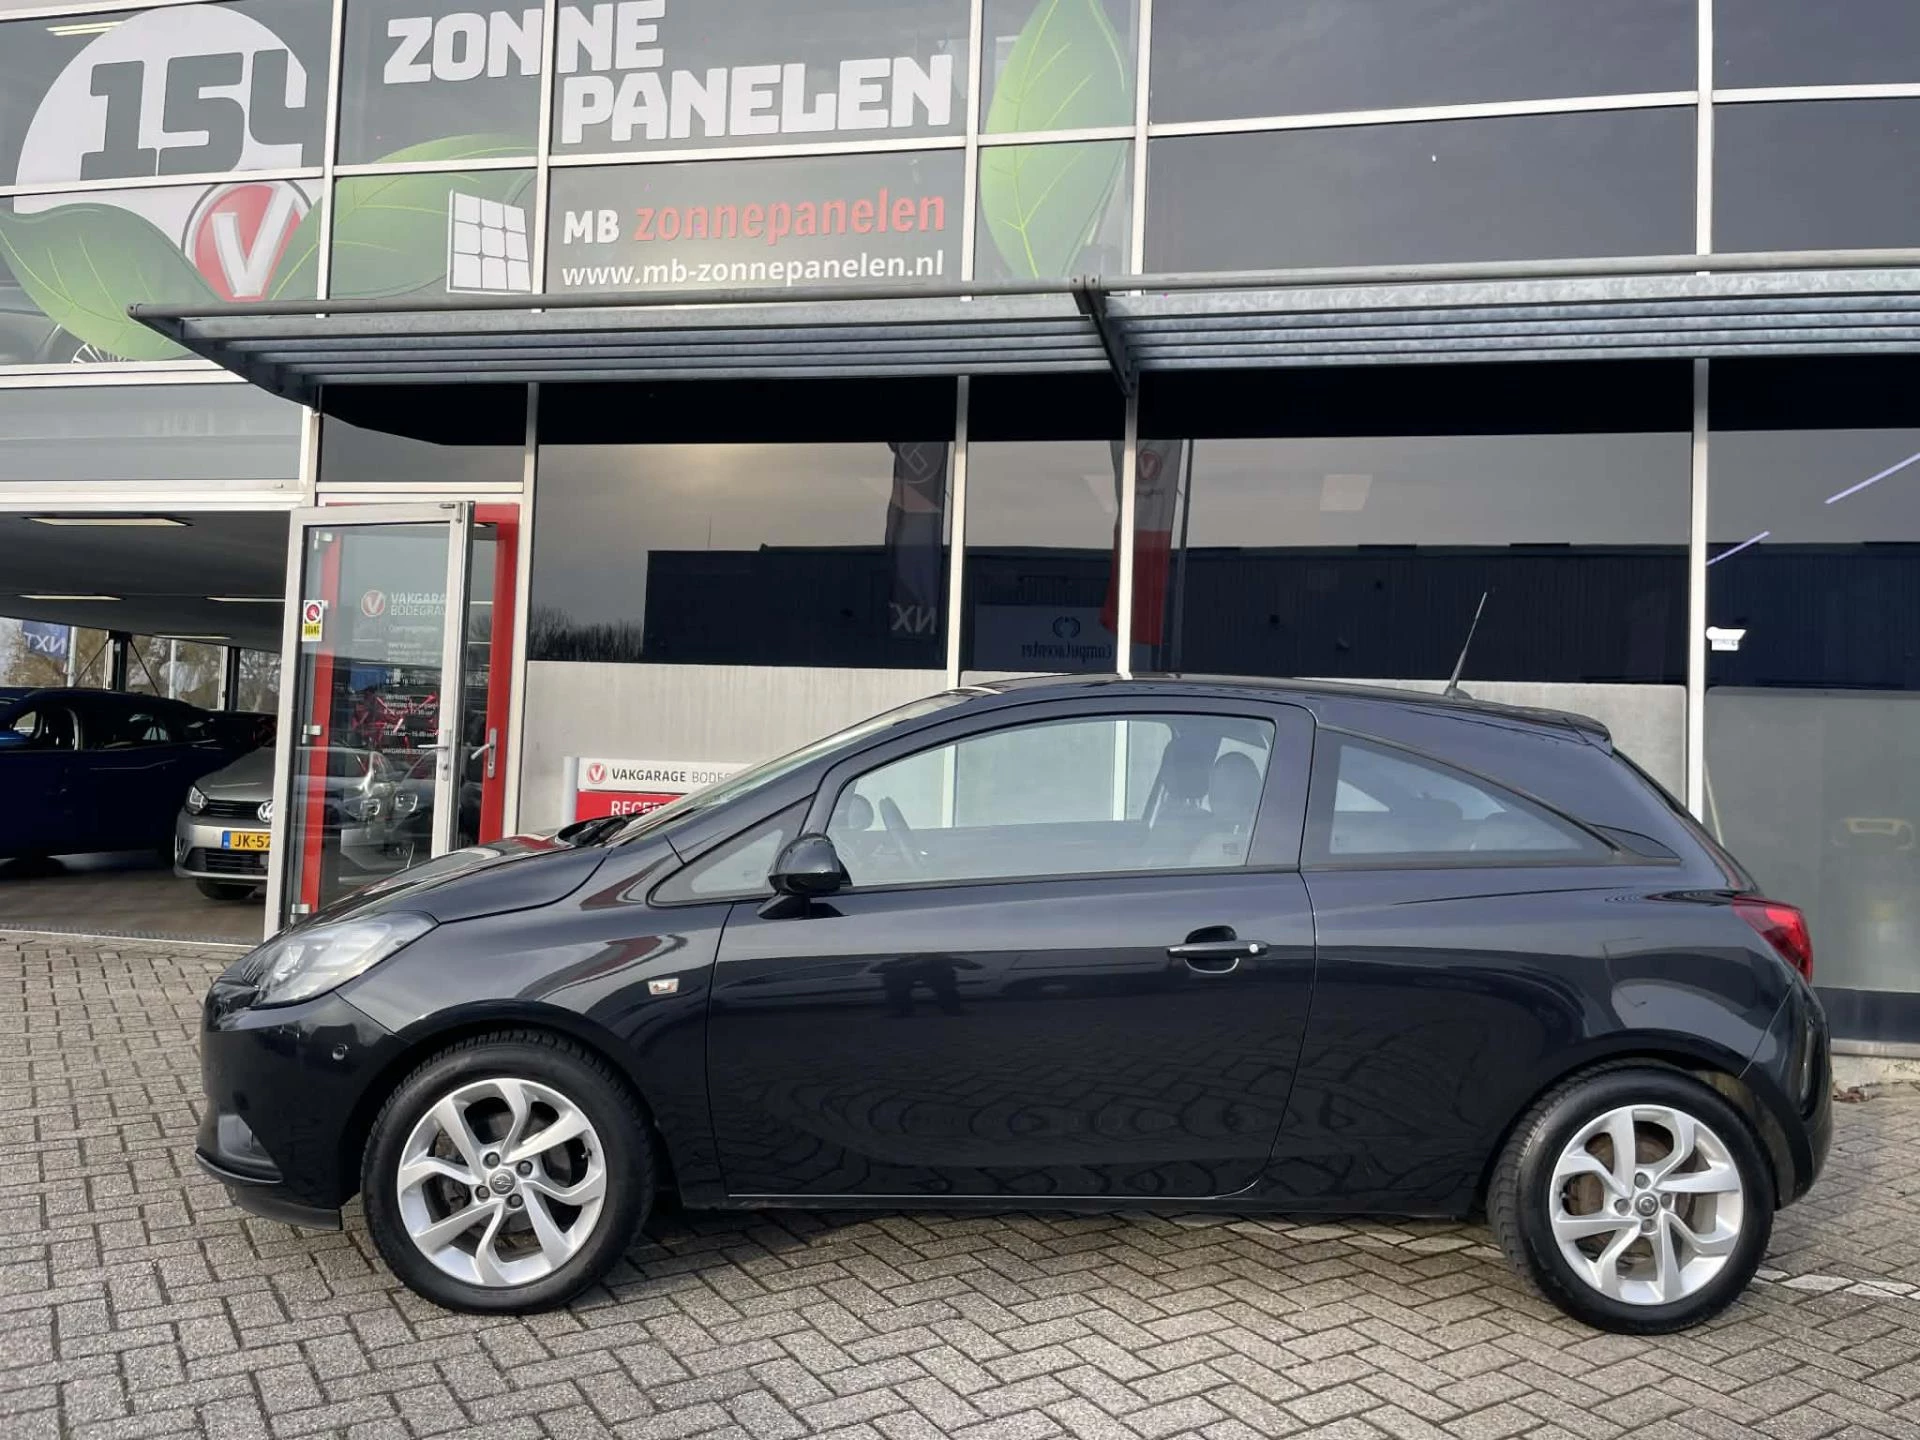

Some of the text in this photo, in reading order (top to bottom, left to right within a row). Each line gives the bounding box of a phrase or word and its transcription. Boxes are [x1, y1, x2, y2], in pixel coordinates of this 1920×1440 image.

[384, 0, 666, 84] ZONNE
[80, 48, 306, 181] 154
[561, 54, 953, 144] PANELEN
[562, 188, 946, 246] MB zonnepanelen
[561, 250, 945, 288] www.mb-zonnepanelen.nl
[612, 767, 686, 783] VAKGARAGE
